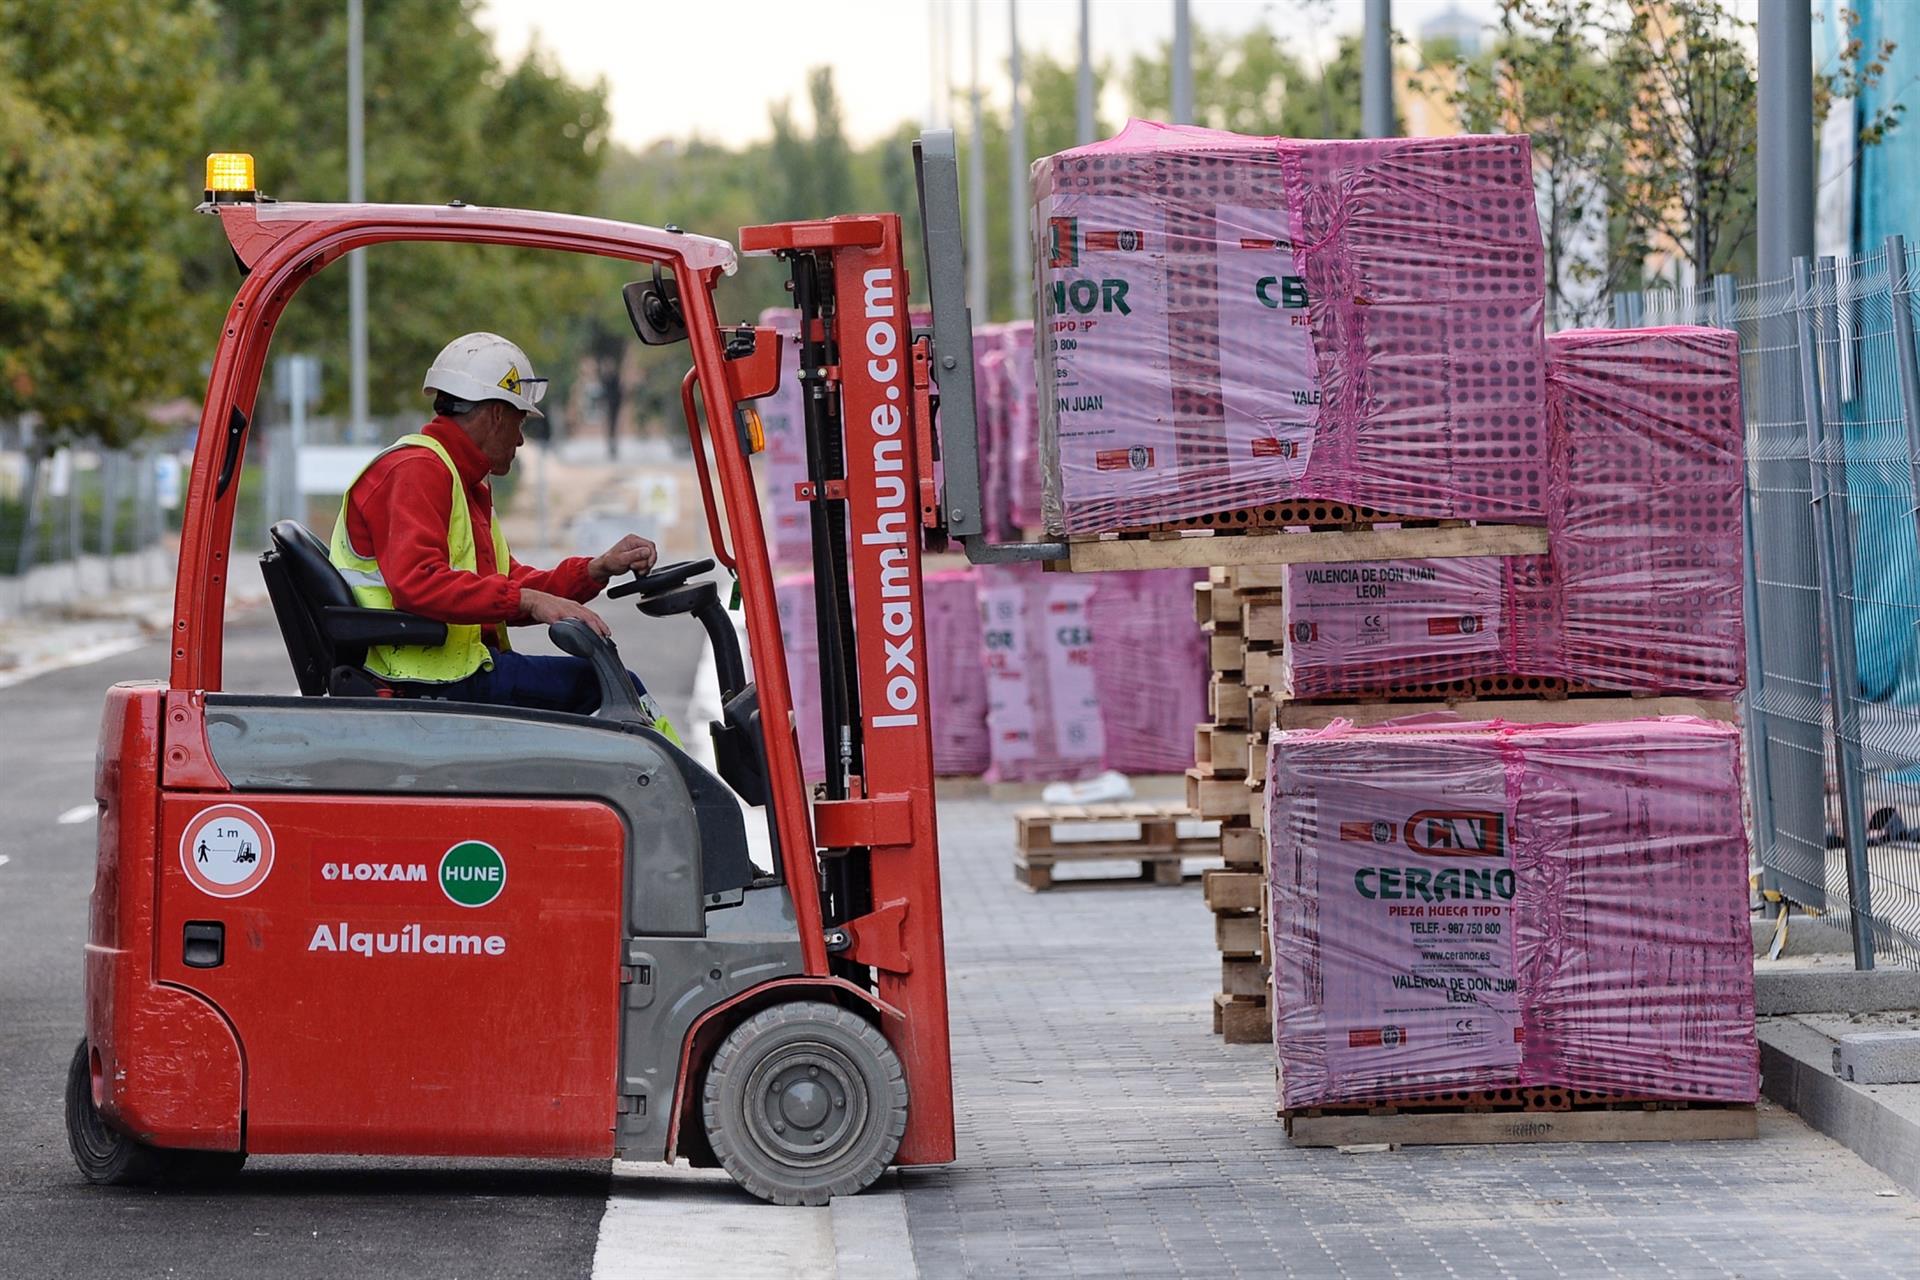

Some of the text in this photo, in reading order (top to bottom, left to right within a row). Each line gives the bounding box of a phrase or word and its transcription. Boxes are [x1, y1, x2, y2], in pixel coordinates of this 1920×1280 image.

[1060, 339, 1077, 351] 800
[1072, 395, 1103, 412] JUAN
[862, 267, 918, 728] loxamhune.com
[1305, 566, 1436, 585] VALENCIA DE DON JUAN
[1356, 584, 1387, 599] LEON
[217, 827, 239, 839] 1 m
[341, 863, 428, 882] LOXAM
[445, 866, 500, 882] HUNE
[1389, 905, 1424, 917] PIEZA
[1429, 905, 1469, 917] HUECA
[1472, 905, 1501, 917] TIPO
[1447, 922, 1464, 935] 987
[1466, 922, 1483, 935] 750
[1484, 922, 1501, 935] 800
[308, 922, 506, 958] Alquílame
[1421, 950, 1491, 961] www.ceranor.es
[1450, 978, 1465, 991] DE
[1467, 977, 1492, 992] DON
